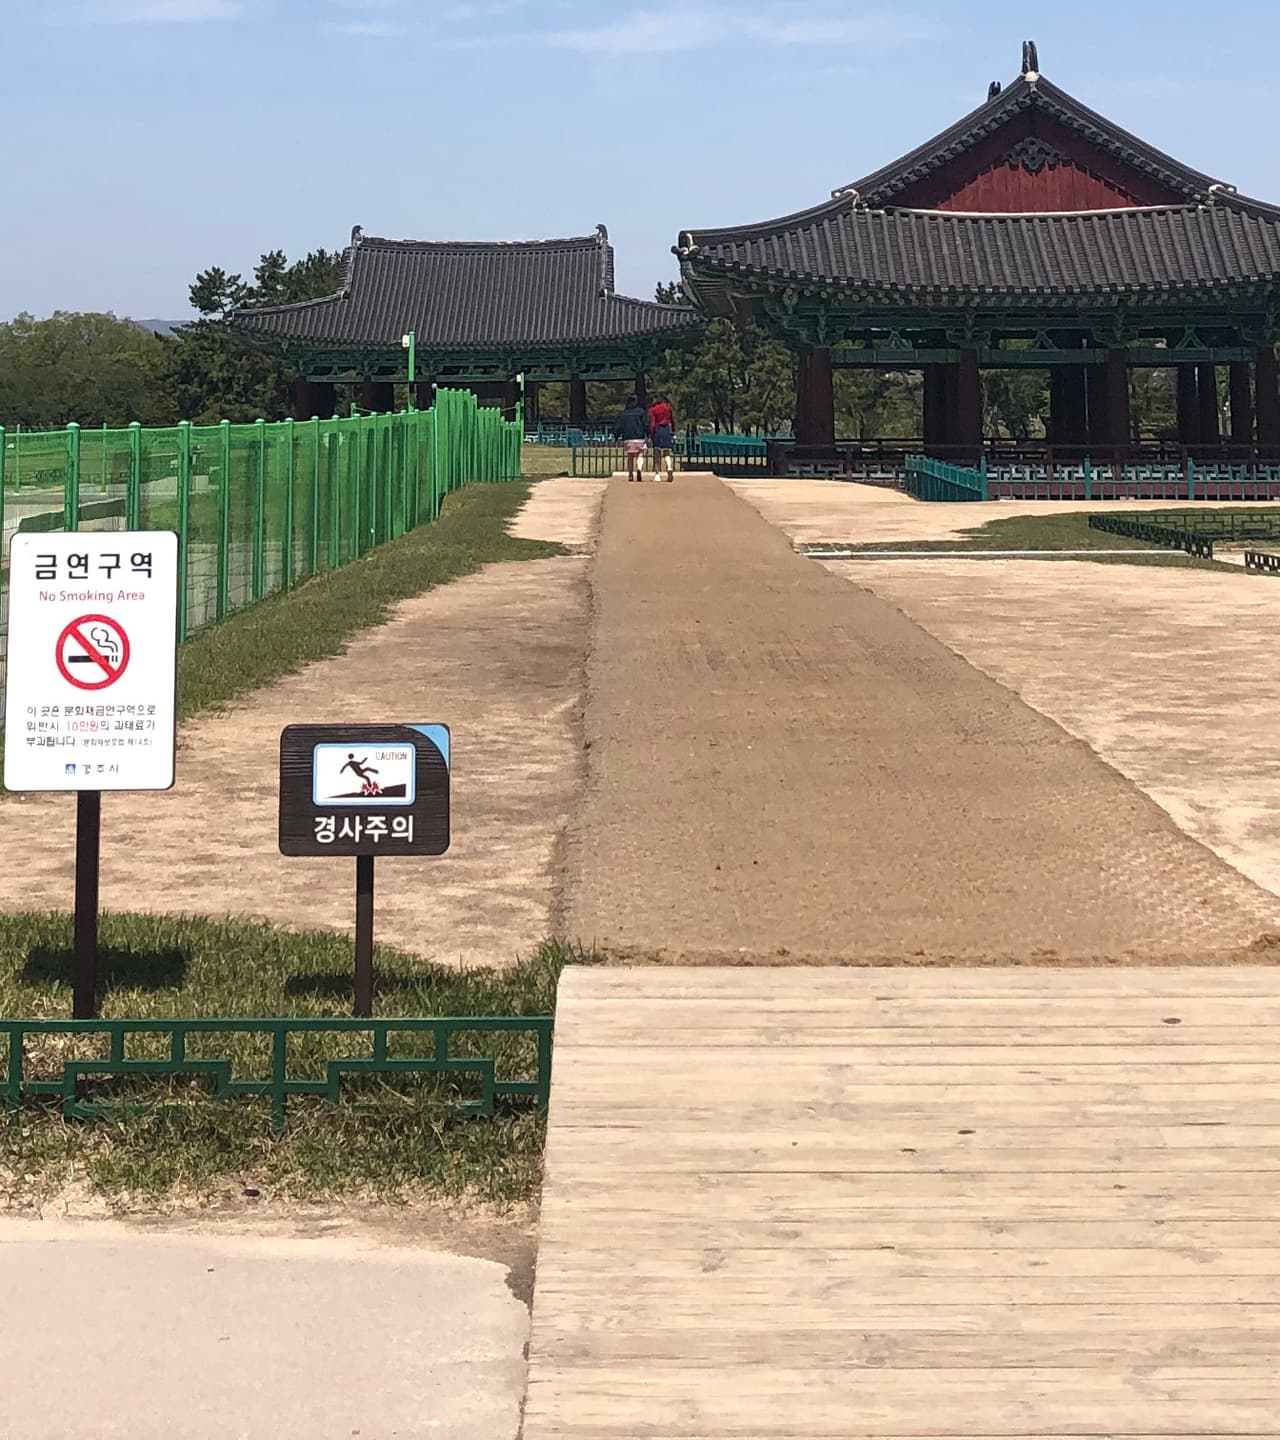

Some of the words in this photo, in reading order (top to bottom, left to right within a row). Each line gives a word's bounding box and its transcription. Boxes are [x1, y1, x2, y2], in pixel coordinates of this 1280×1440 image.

[35, 552, 152, 580] 금연구역
[39, 591, 56, 602] No
[59, 590, 113, 603] Smoking
[117, 590, 145, 601] Area
[375, 752, 408, 761] CAUTION
[314, 815, 414, 843] 경사주의
